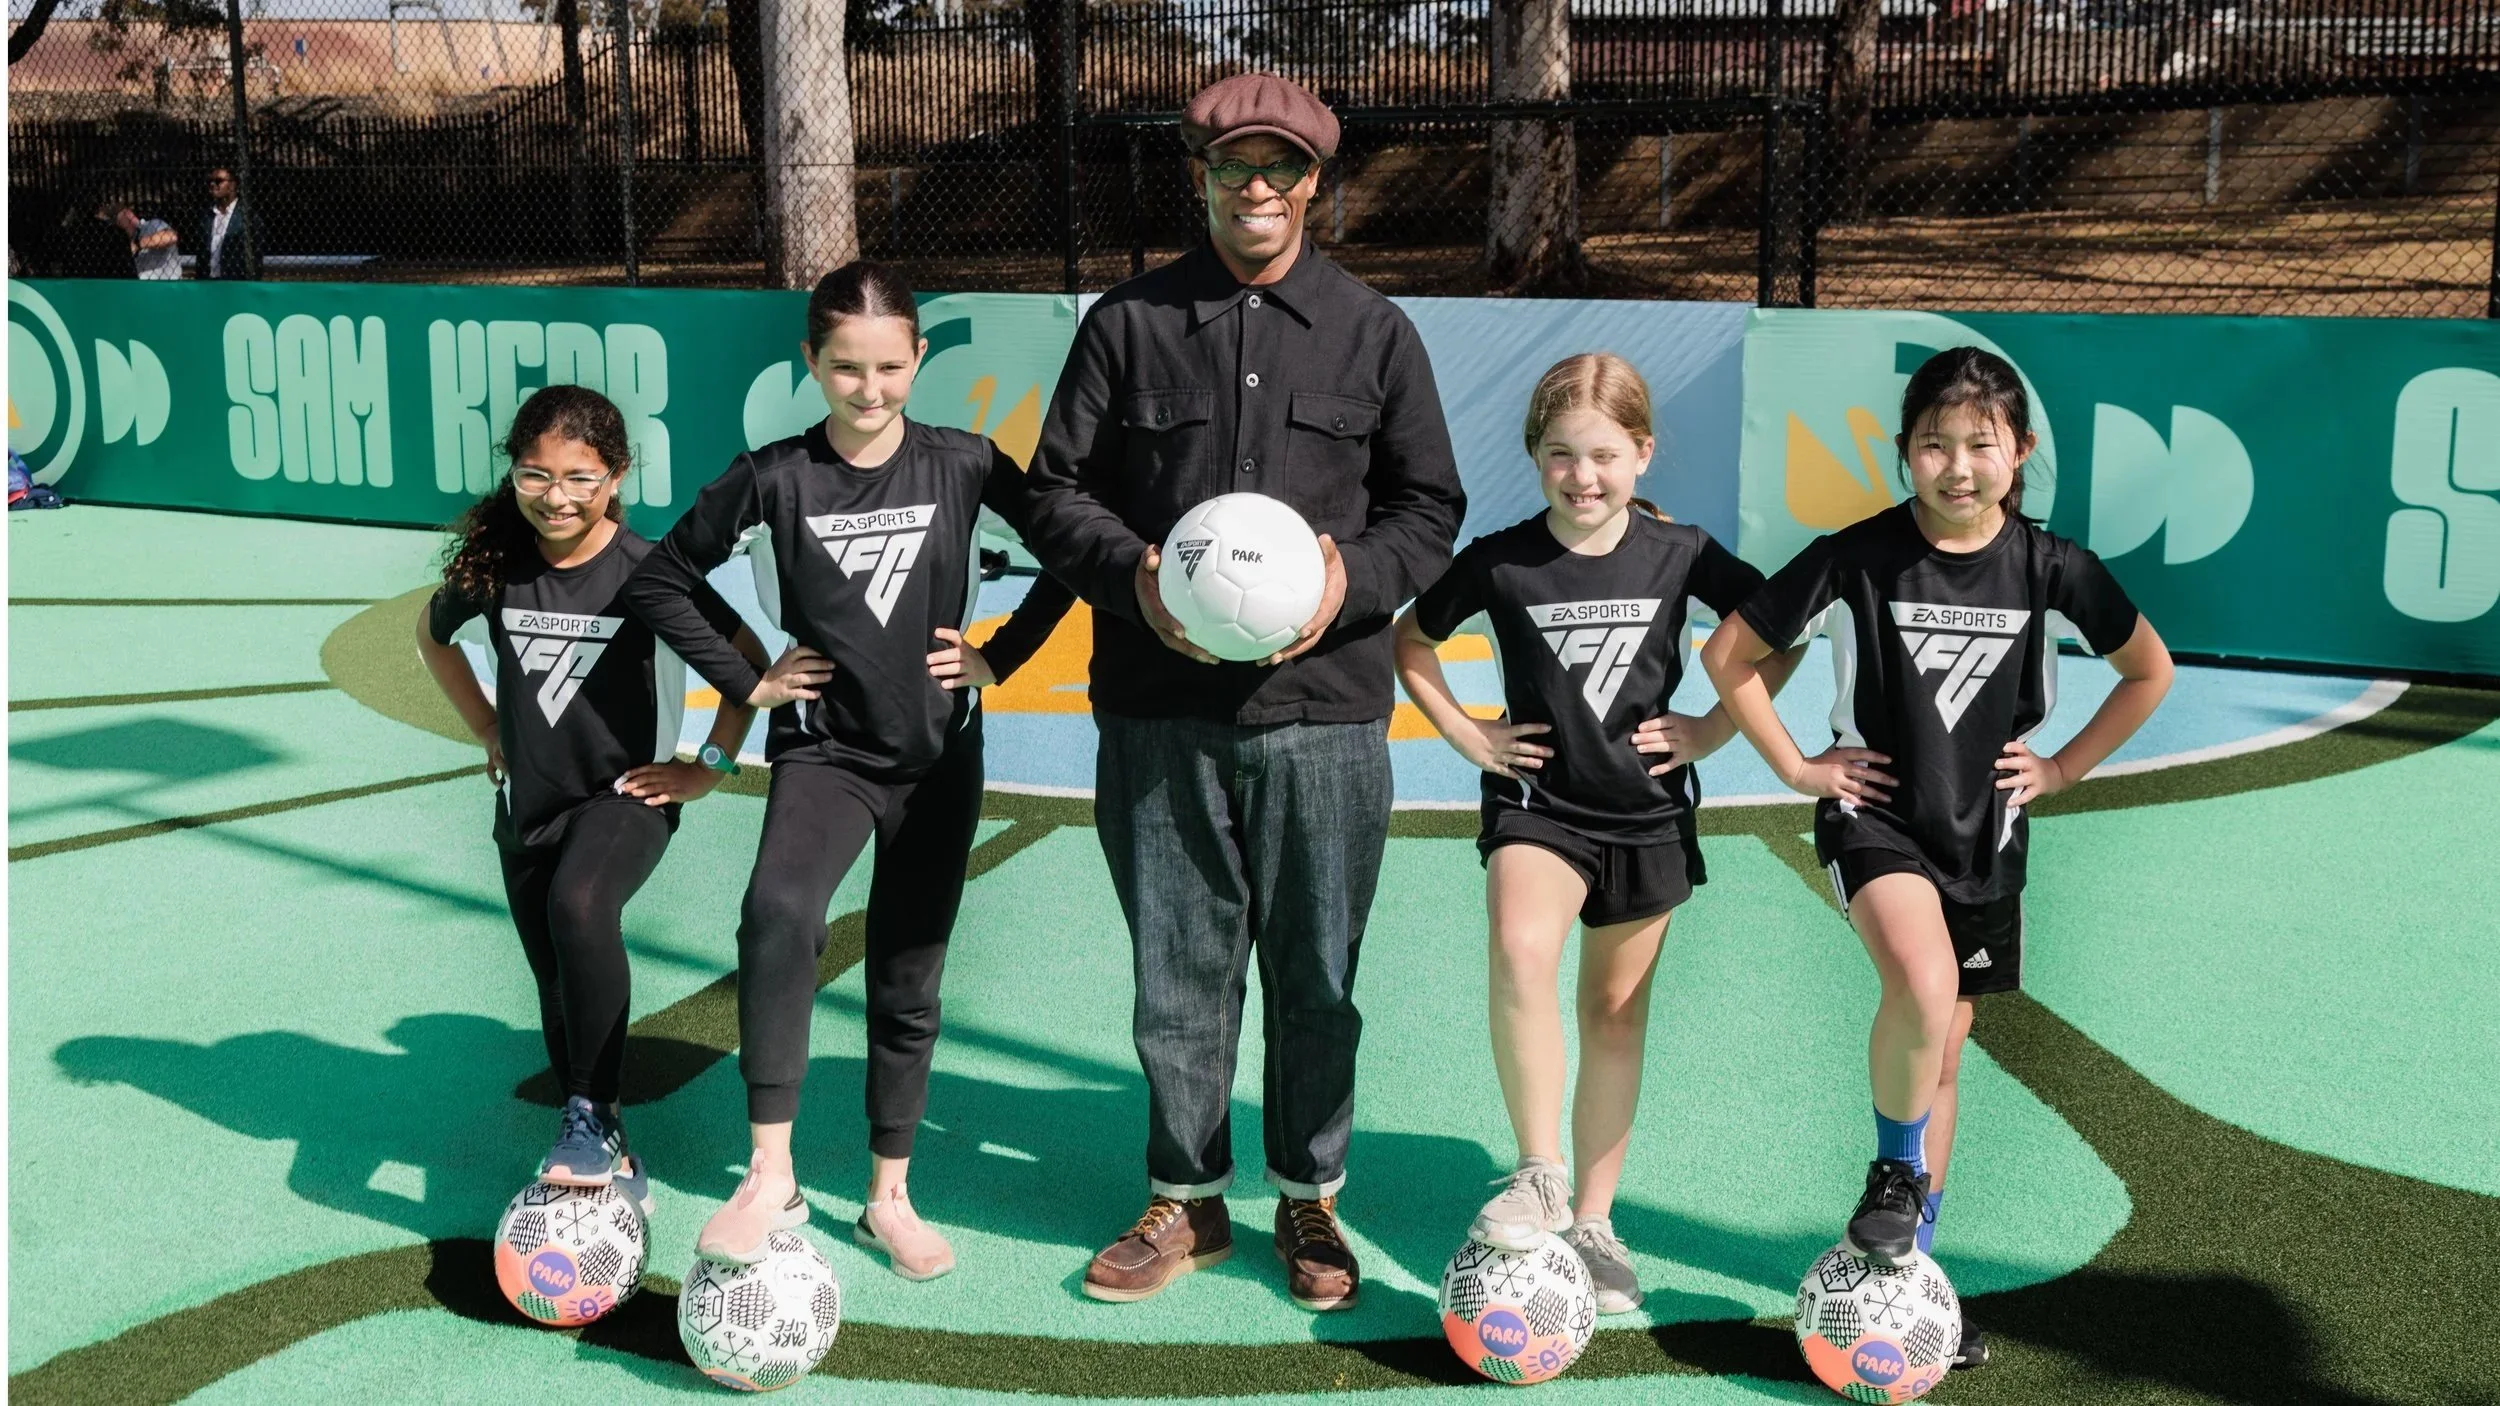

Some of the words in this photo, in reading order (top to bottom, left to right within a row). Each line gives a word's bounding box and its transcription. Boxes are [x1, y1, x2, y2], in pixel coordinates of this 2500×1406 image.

[223, 313, 393, 488] SAM
[857, 511, 916, 529] SPORTS
[1232, 549, 1263, 563] PARK
[1578, 604, 1640, 620] SPORTS
[1941, 610, 2007, 628] SPORTS
[541, 617, 600, 634] SPORTS
[1963, 960, 1992, 968] adidas
[609, 1211, 638, 1243] PARK
[532, 1261, 573, 1289] PARK
[1541, 1256, 1576, 1284] PARK
[1919, 1283, 1950, 1311] PARK
[774, 1318, 807, 1334] LIFE
[1482, 1324, 1525, 1345] PARK
[769, 1332, 807, 1347] PARK
[1856, 1352, 1902, 1376] PARK
